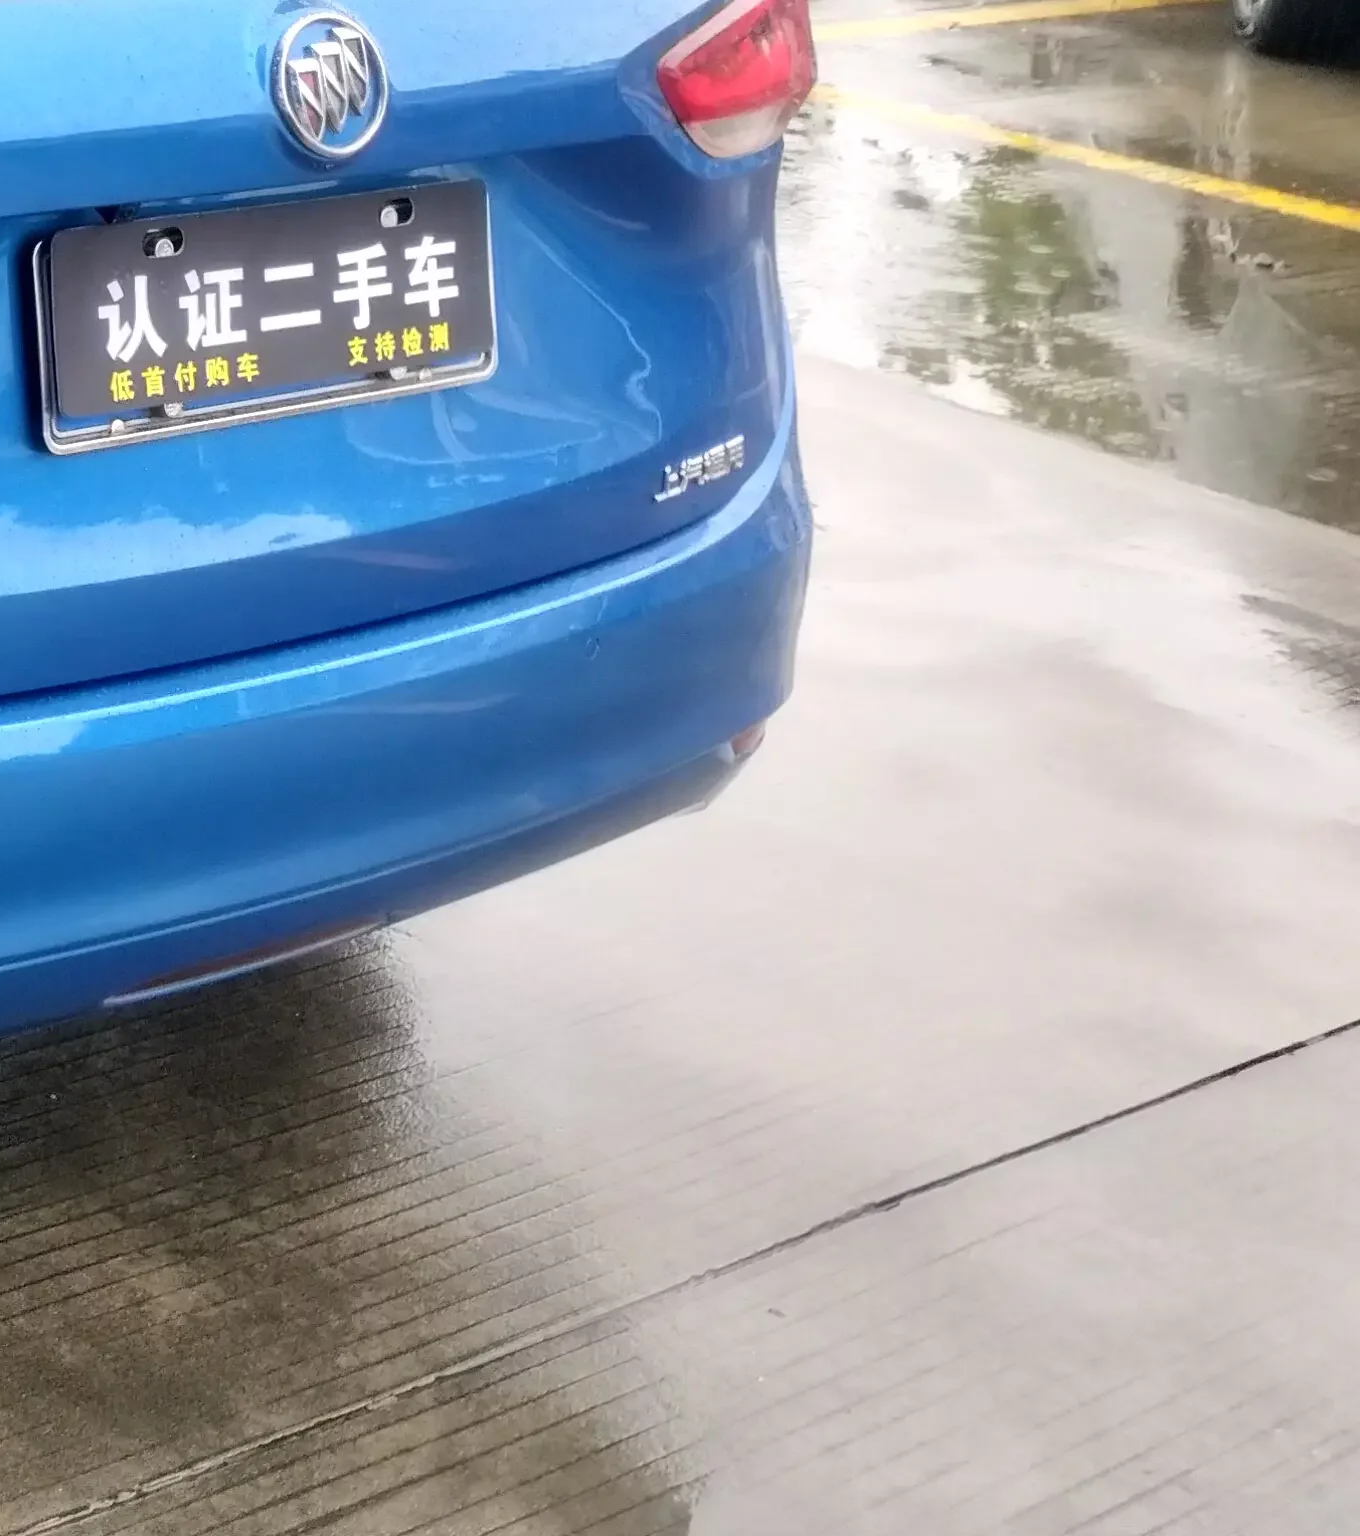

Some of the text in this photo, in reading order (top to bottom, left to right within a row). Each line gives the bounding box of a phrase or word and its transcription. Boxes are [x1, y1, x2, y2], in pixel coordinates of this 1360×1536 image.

[97, 235, 461, 363] 认证二手车
[346, 321, 451, 367] 支持检测
[108, 353, 261, 404] 低首付购车
